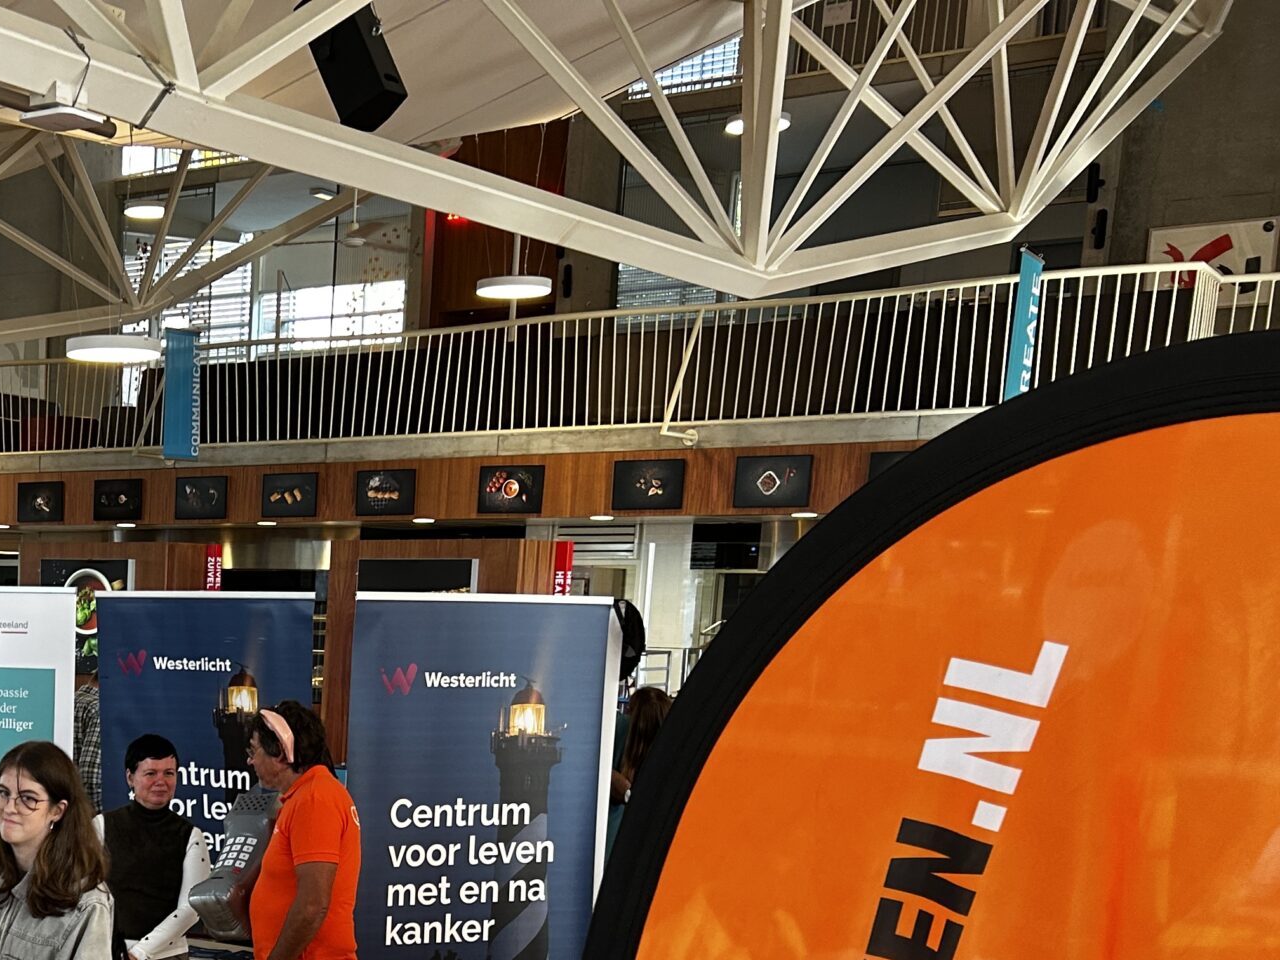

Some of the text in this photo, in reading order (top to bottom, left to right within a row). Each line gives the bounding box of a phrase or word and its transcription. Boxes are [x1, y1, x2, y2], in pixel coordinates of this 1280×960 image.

[1019, 272, 1042, 393] REATE
[190, 336, 201, 456] COMMUNICATE
[207, 556, 215, 590] ZUIVEL
[153, 656, 232, 672] Westerlicht
[425, 671, 517, 688] Westerlicht
[177, 760, 251, 791] ntrum
[169, 797, 196, 817] or
[390, 797, 531, 829] Centrum
[388, 835, 555, 868] voor leven
[386, 876, 546, 907] met en na
[385, 913, 496, 946] kanker
